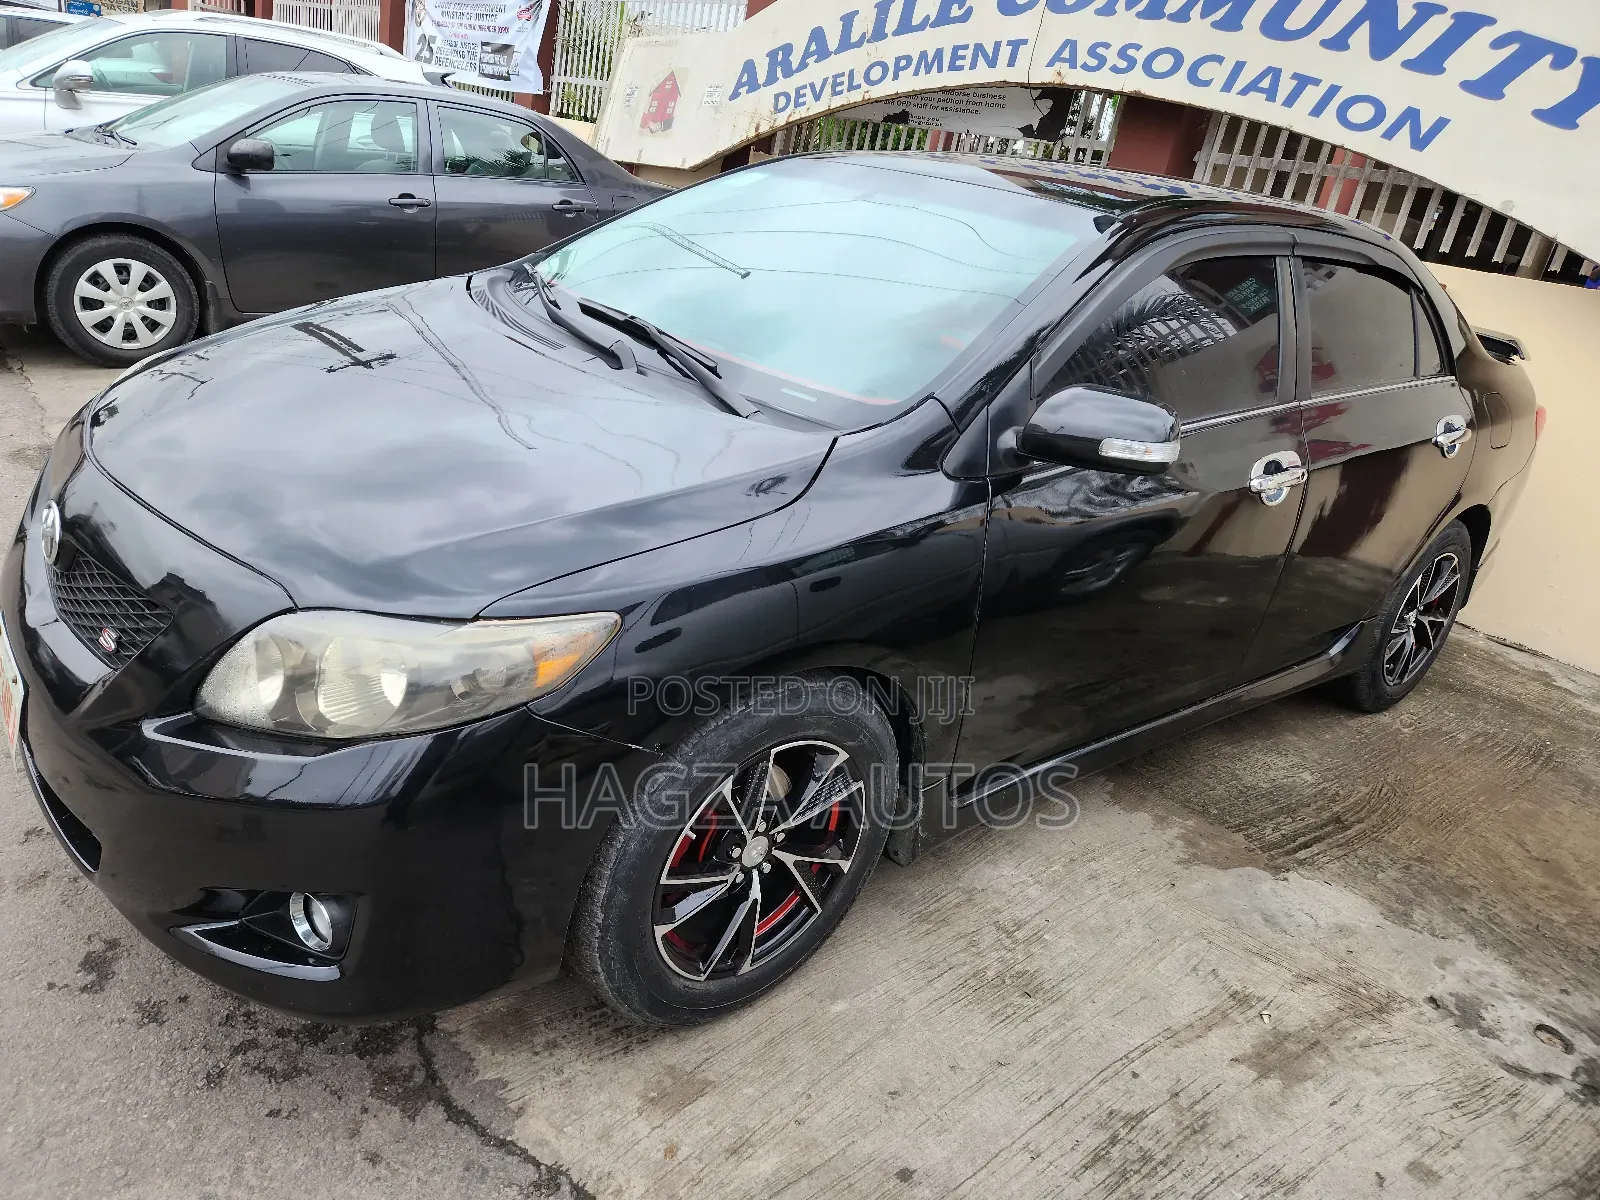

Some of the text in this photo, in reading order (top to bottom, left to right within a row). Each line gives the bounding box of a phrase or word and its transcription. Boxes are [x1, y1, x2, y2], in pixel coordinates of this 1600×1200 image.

[474, 13, 498, 22] JUSTICE
[414, 33, 437, 64] 25
[435, 46, 478, 60] DEFENDING THE
[729, 0, 973, 100] ARALILE
[434, 55, 477, 73] DEFENCELESS
[773, 38, 1452, 152] DEVELOPMENT ASSOCIATION
[912, 102, 928, 110] staff
[929, 103, 940, 111] for
[940, 105, 981, 115] assistance.
[965, 99, 983, 107] from
[909, 113, 926, 121] hank
